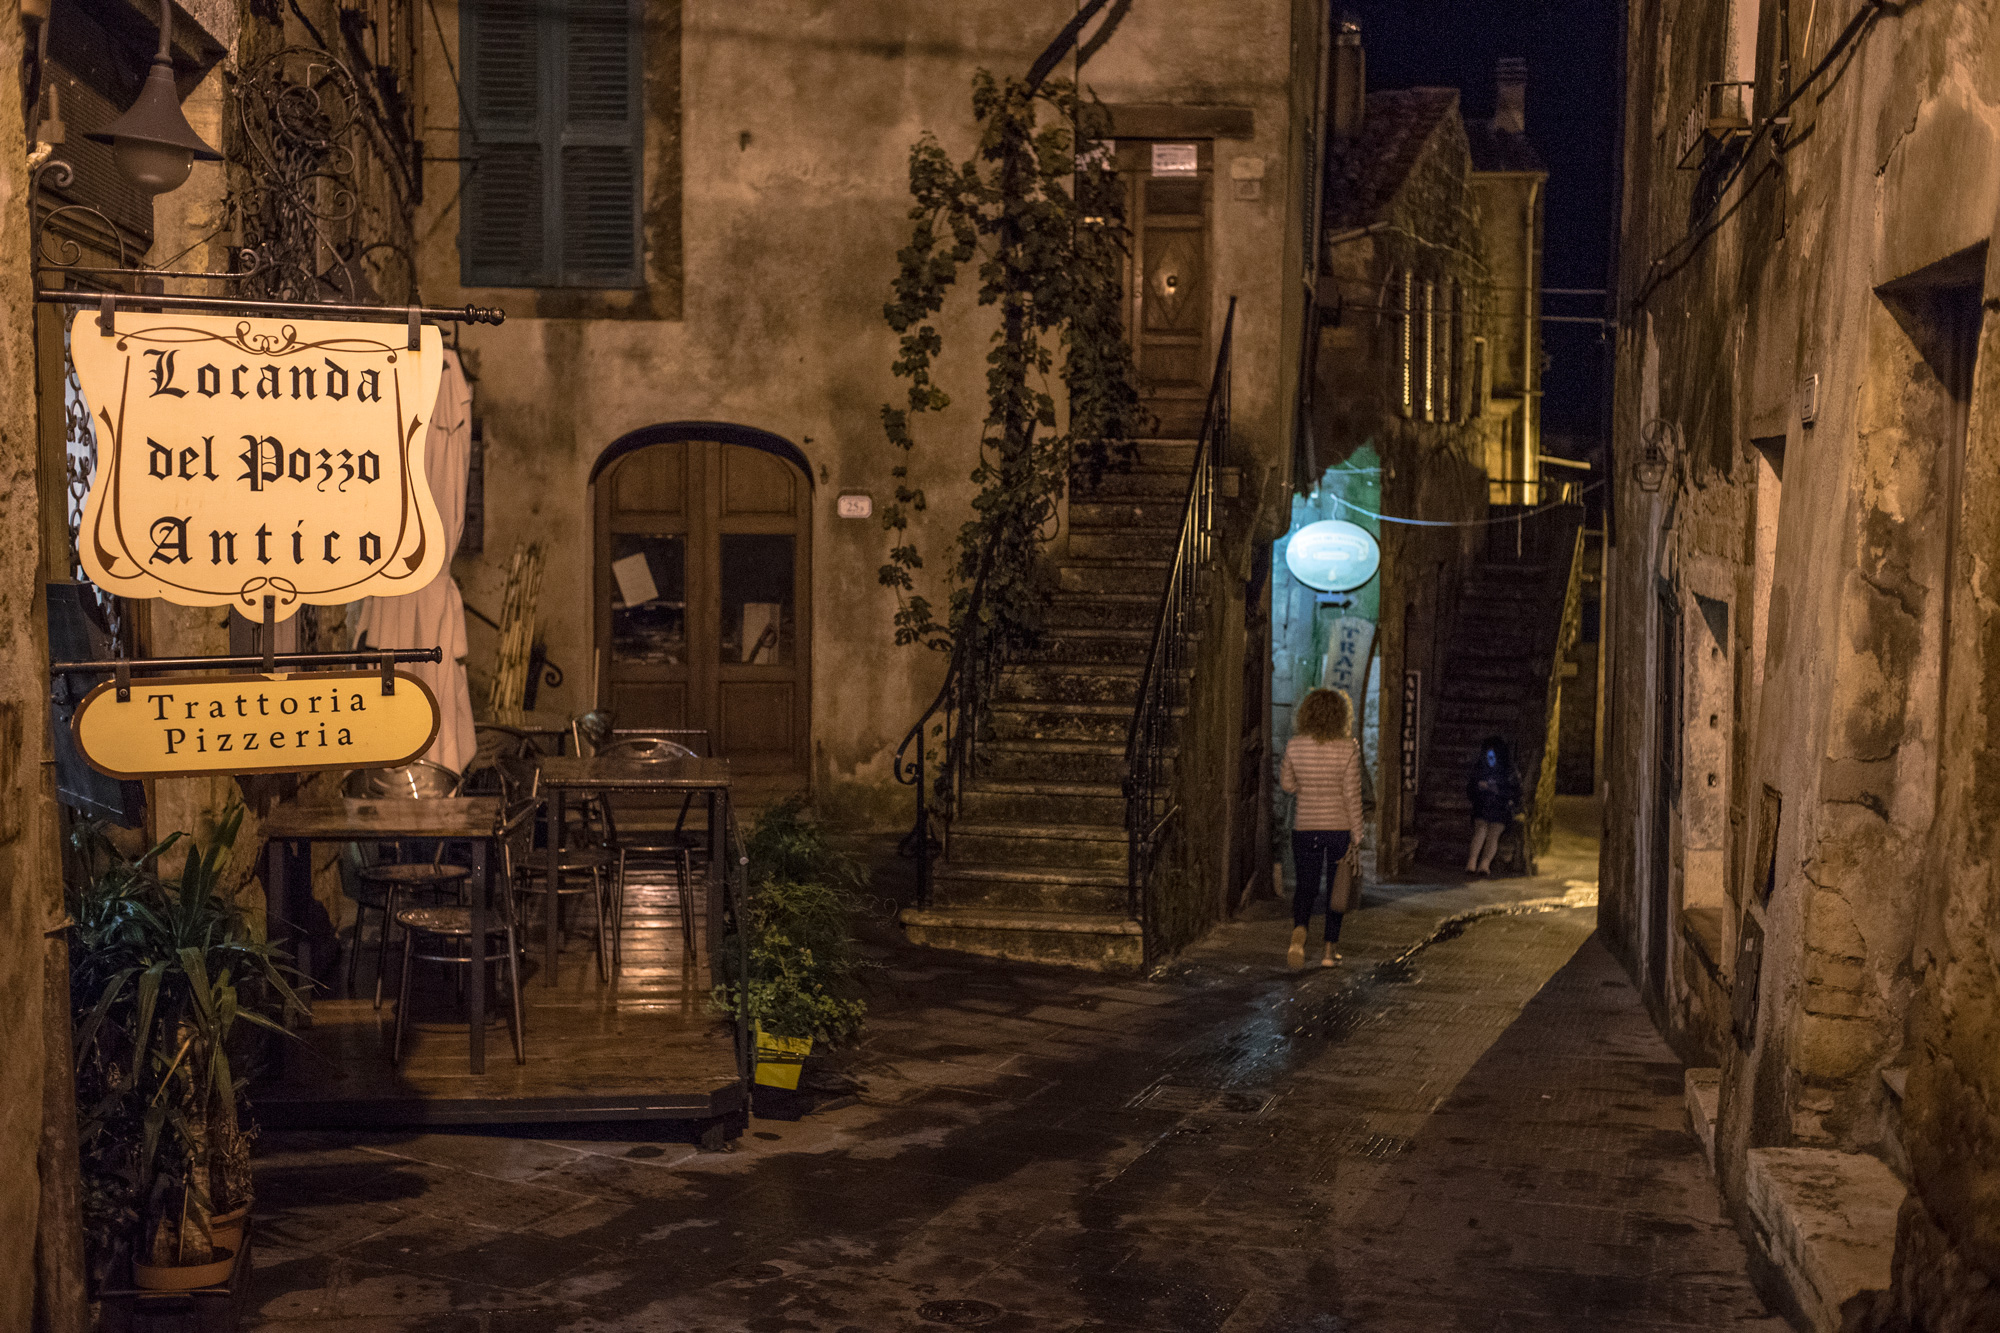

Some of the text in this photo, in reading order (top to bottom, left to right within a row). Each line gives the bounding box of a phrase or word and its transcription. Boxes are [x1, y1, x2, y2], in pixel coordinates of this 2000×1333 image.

[144, 348, 382, 403] Locanda
[146, 434, 381, 493] del Pozzo
[148, 516, 382, 566] Antico
[148, 688, 367, 721] Trattoria
[163, 722, 354, 755] Pizzeria
